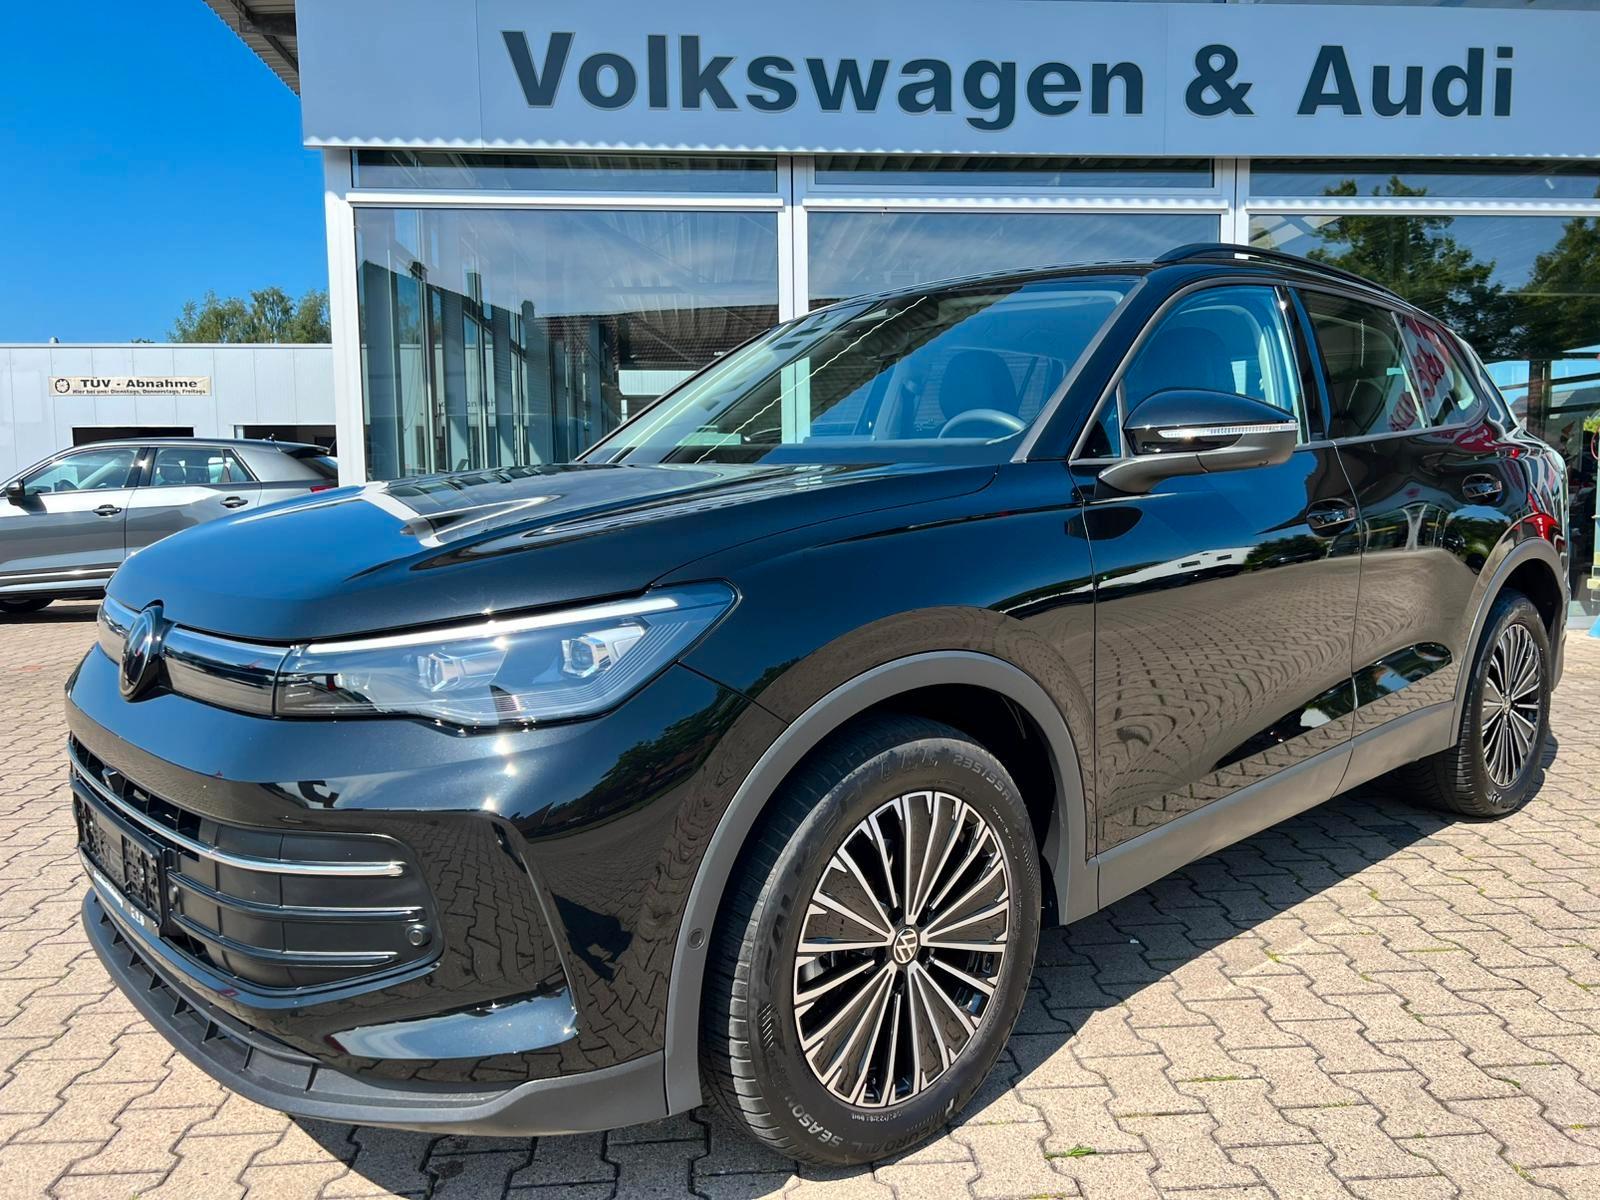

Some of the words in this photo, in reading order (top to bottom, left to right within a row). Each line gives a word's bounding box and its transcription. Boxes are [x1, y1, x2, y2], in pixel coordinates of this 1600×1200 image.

[501, 30, 1144, 132] Volkswagen
[1185, 43, 1256, 117] &
[1296, 44, 1515, 117] Audi
[80, 376, 111, 388] TÜV
[126, 379, 198, 388] Abnahme
[783, 1094, 846, 1149] SEASON
